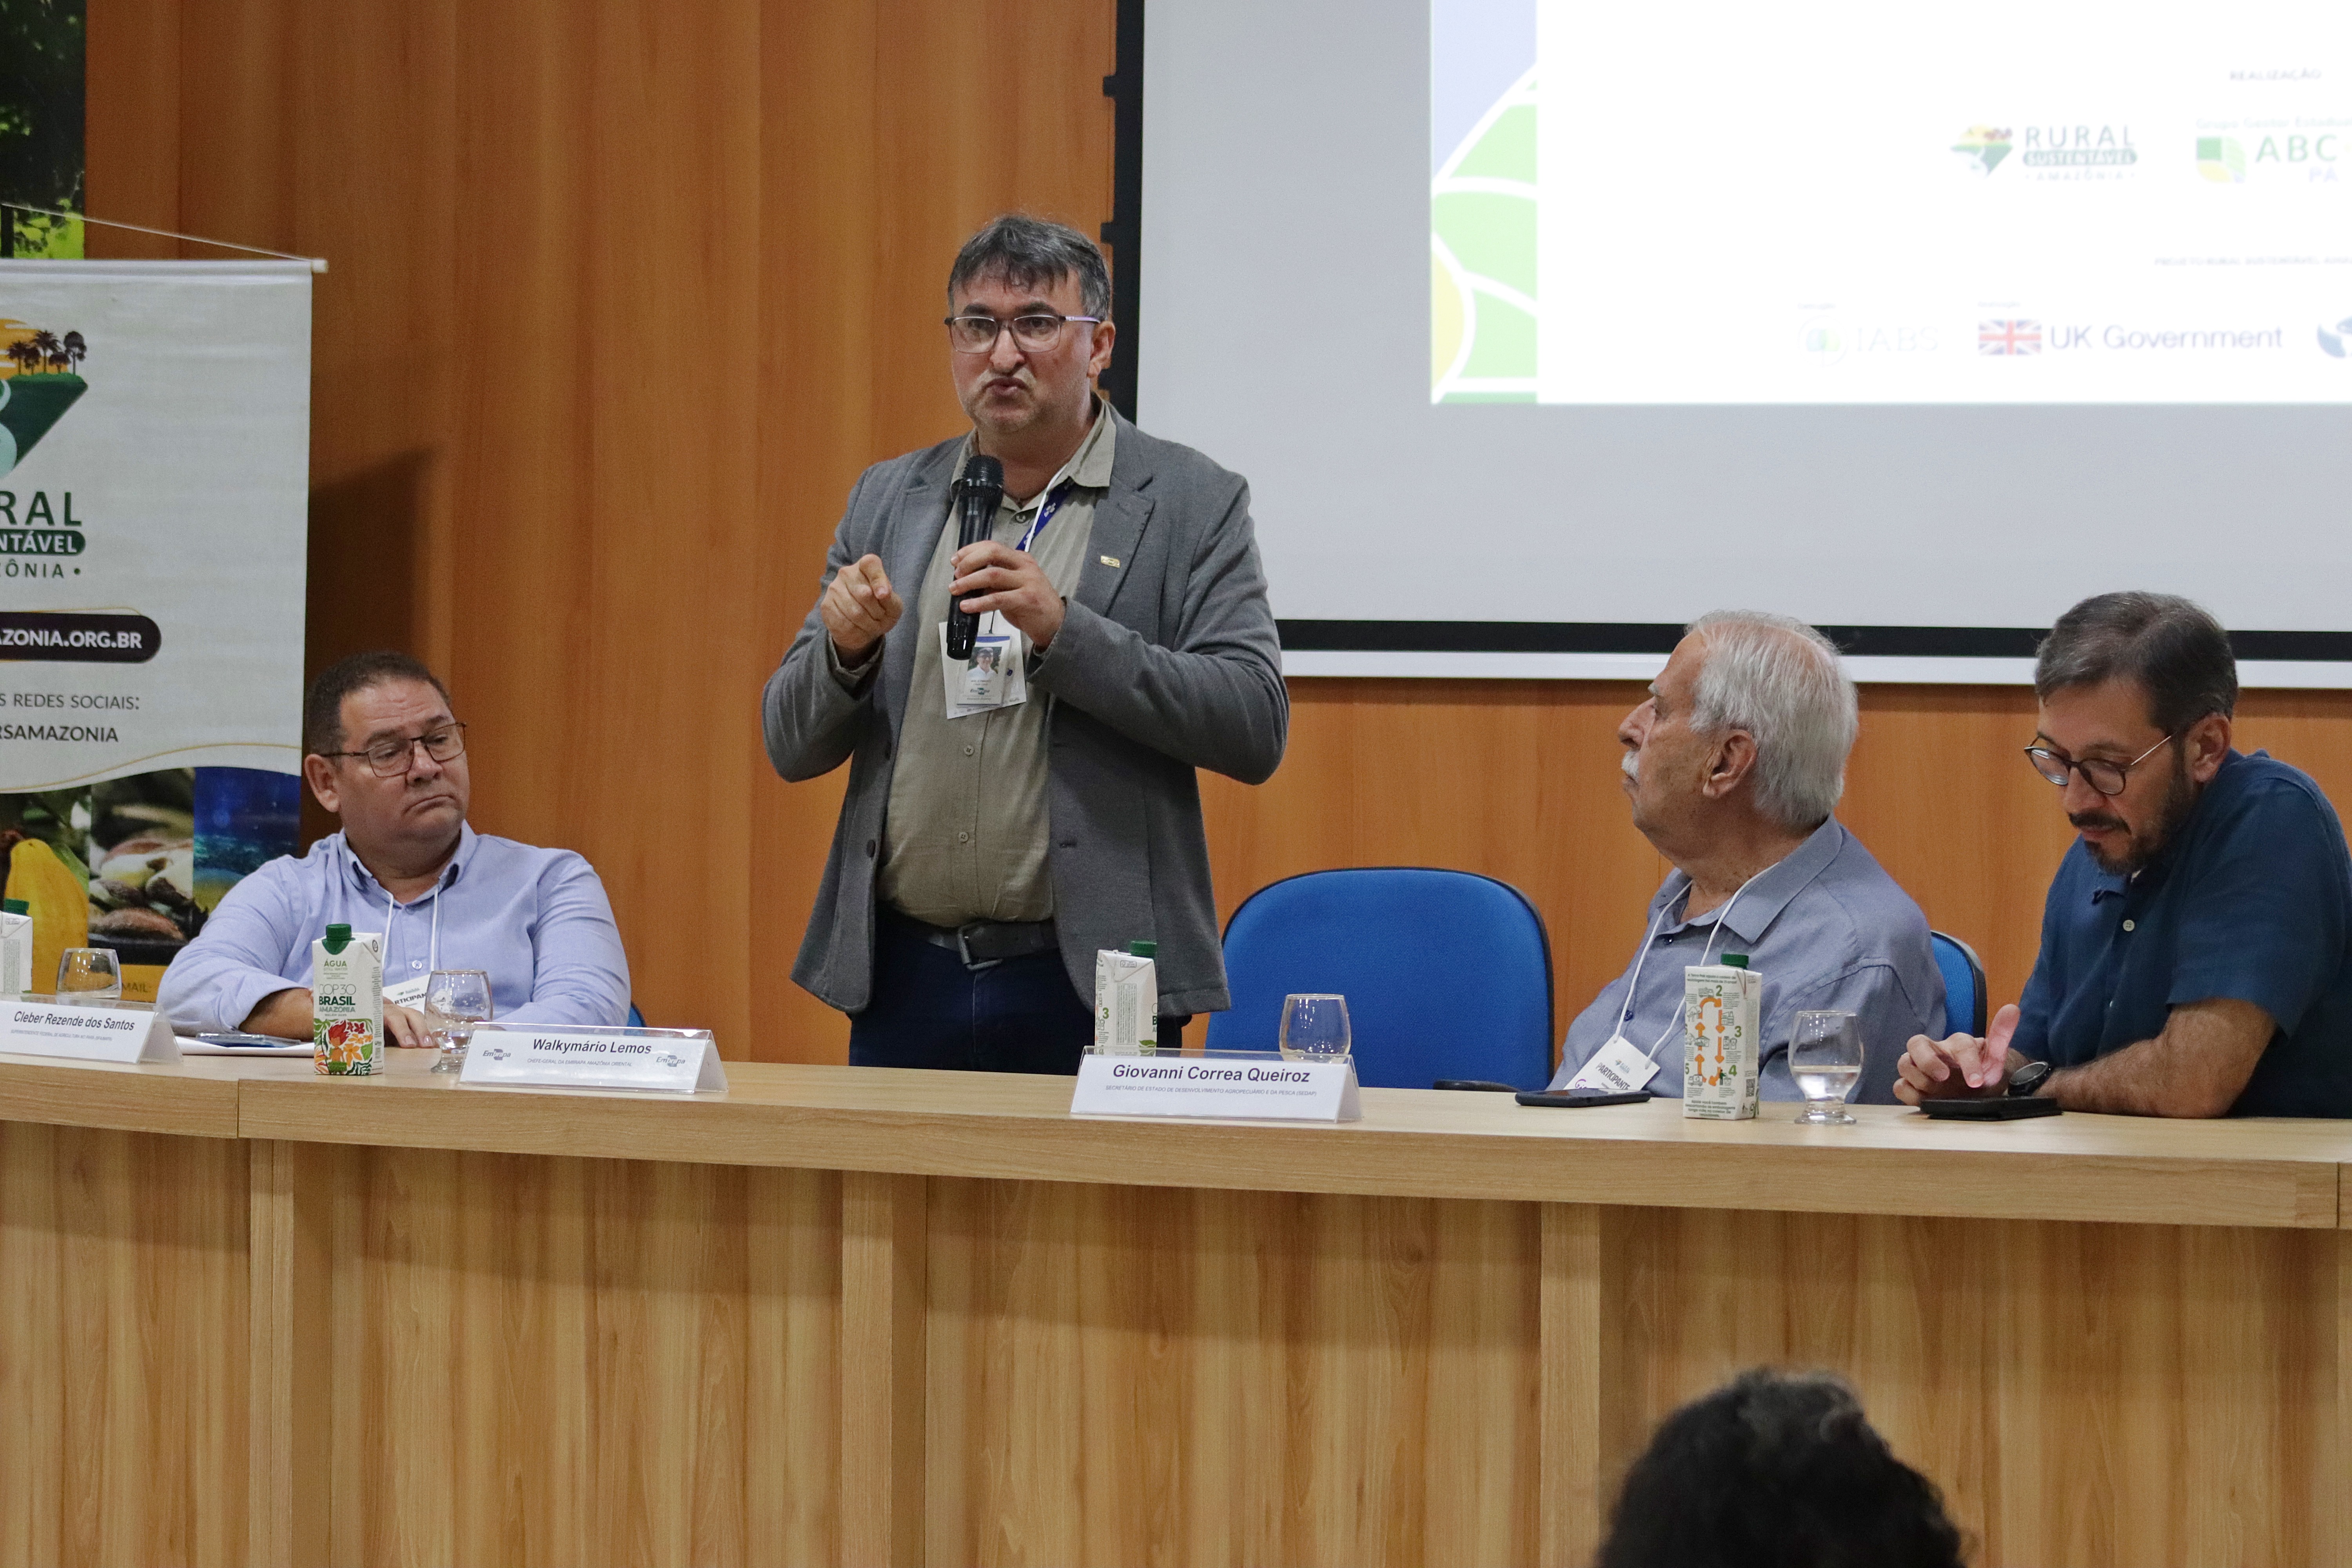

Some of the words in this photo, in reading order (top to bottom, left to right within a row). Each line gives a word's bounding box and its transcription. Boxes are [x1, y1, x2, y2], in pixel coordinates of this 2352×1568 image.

[2025, 124, 2135, 148] RURAL
[2255, 133, 2338, 163] ABC
[2051, 325, 2093, 348] UK
[2103, 324, 2283, 349] Government
[0, 559, 64, 578] ÔNIA
[0, 629, 142, 649] ZONIA.ORG.BR
[14, 693, 64, 708] REDES
[71, 695, 140, 710] SOCIAIS:
[0, 725, 118, 742] SAMAZONIA
[1716, 985, 1722, 996] 2
[319, 996, 356, 1005] BRASIL
[14, 1011, 44, 1024] Cleber
[45, 1013, 83, 1027] Rezende
[85, 1017, 102, 1028] dos
[103, 1018, 135, 1031] Santos
[1103, 1007, 1109, 1019] 3
[1735, 1025, 1742, 1037] 3
[533, 1039, 607, 1054] Walkymário
[610, 1042, 652, 1054] Lemos
[1113, 1064, 1183, 1079] Giovanni
[1188, 1066, 1242, 1080] Correa
[1248, 1068, 1310, 1082] Queiroz
[1728, 1065, 1737, 1076] 4
